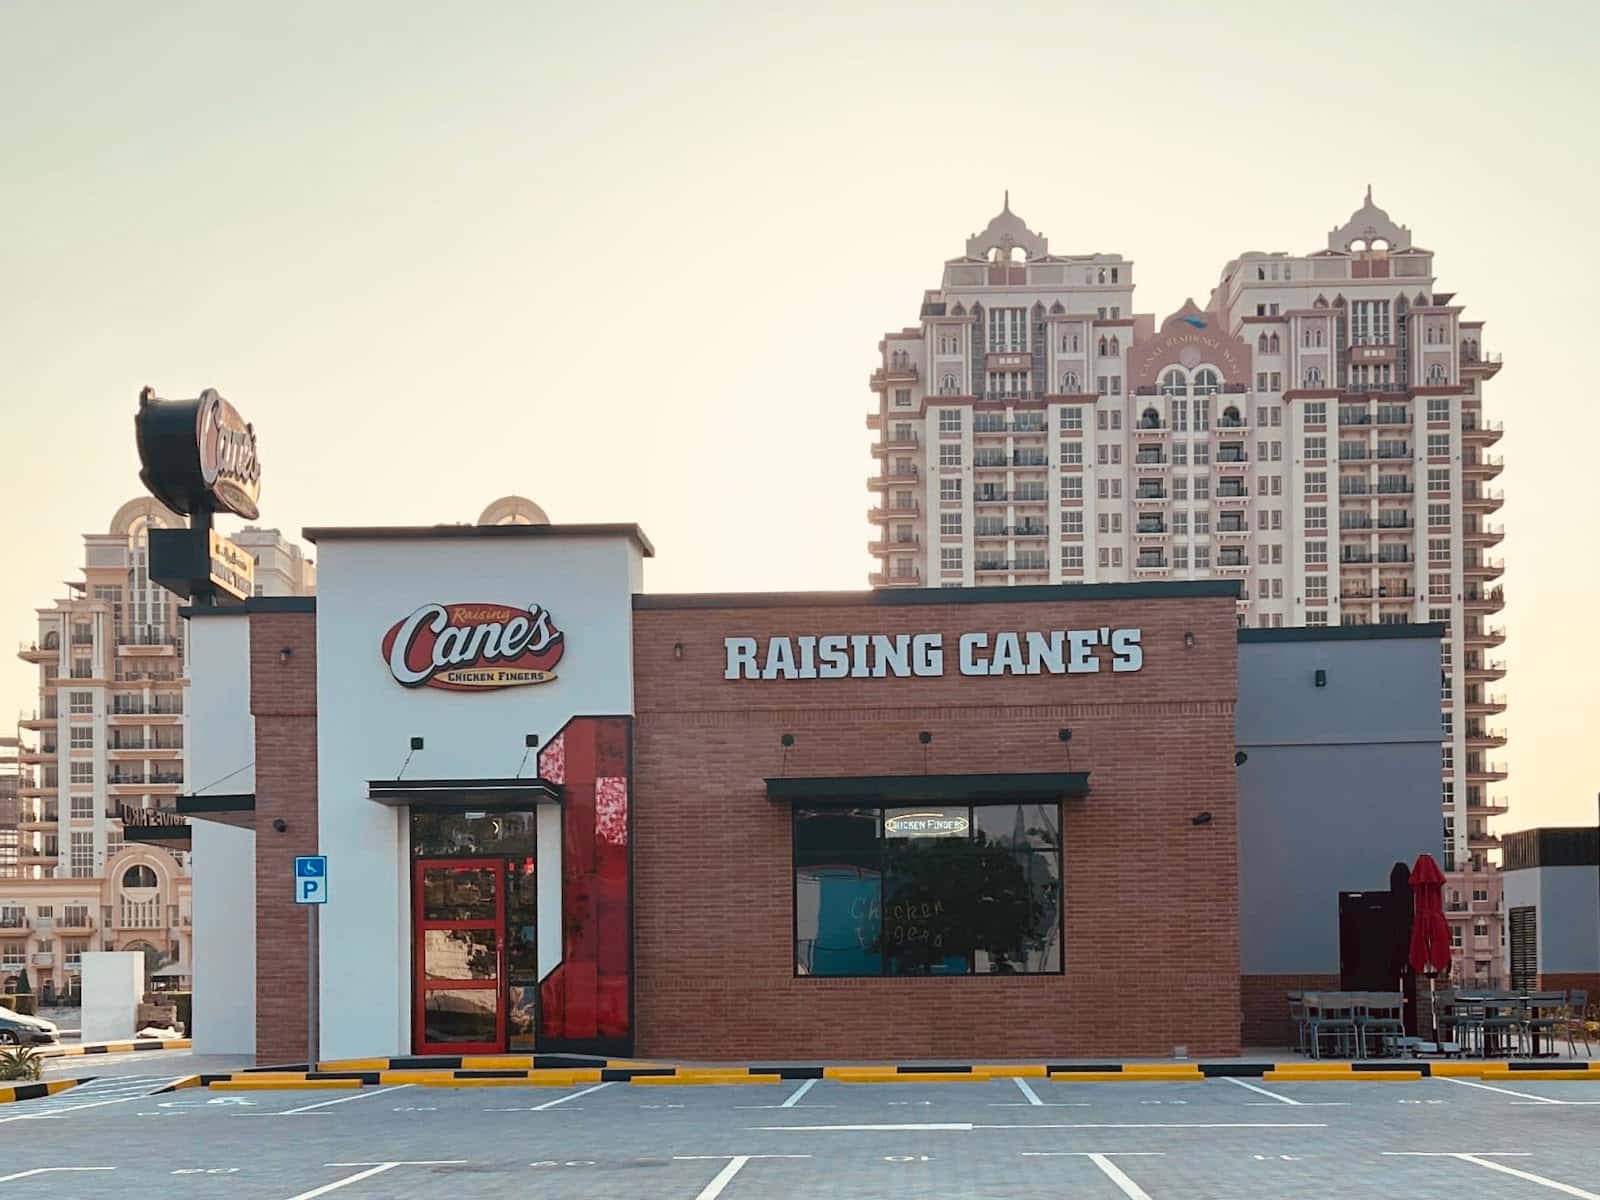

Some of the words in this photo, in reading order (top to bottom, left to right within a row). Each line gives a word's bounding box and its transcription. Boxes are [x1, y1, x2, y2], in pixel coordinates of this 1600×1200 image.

[451, 606, 511, 623] Raising
[390, 603, 564, 687] Cane's
[724, 633, 944, 680] RAISING
[959, 627, 1143, 676] CANE'S
[304, 881, 318, 899] P
